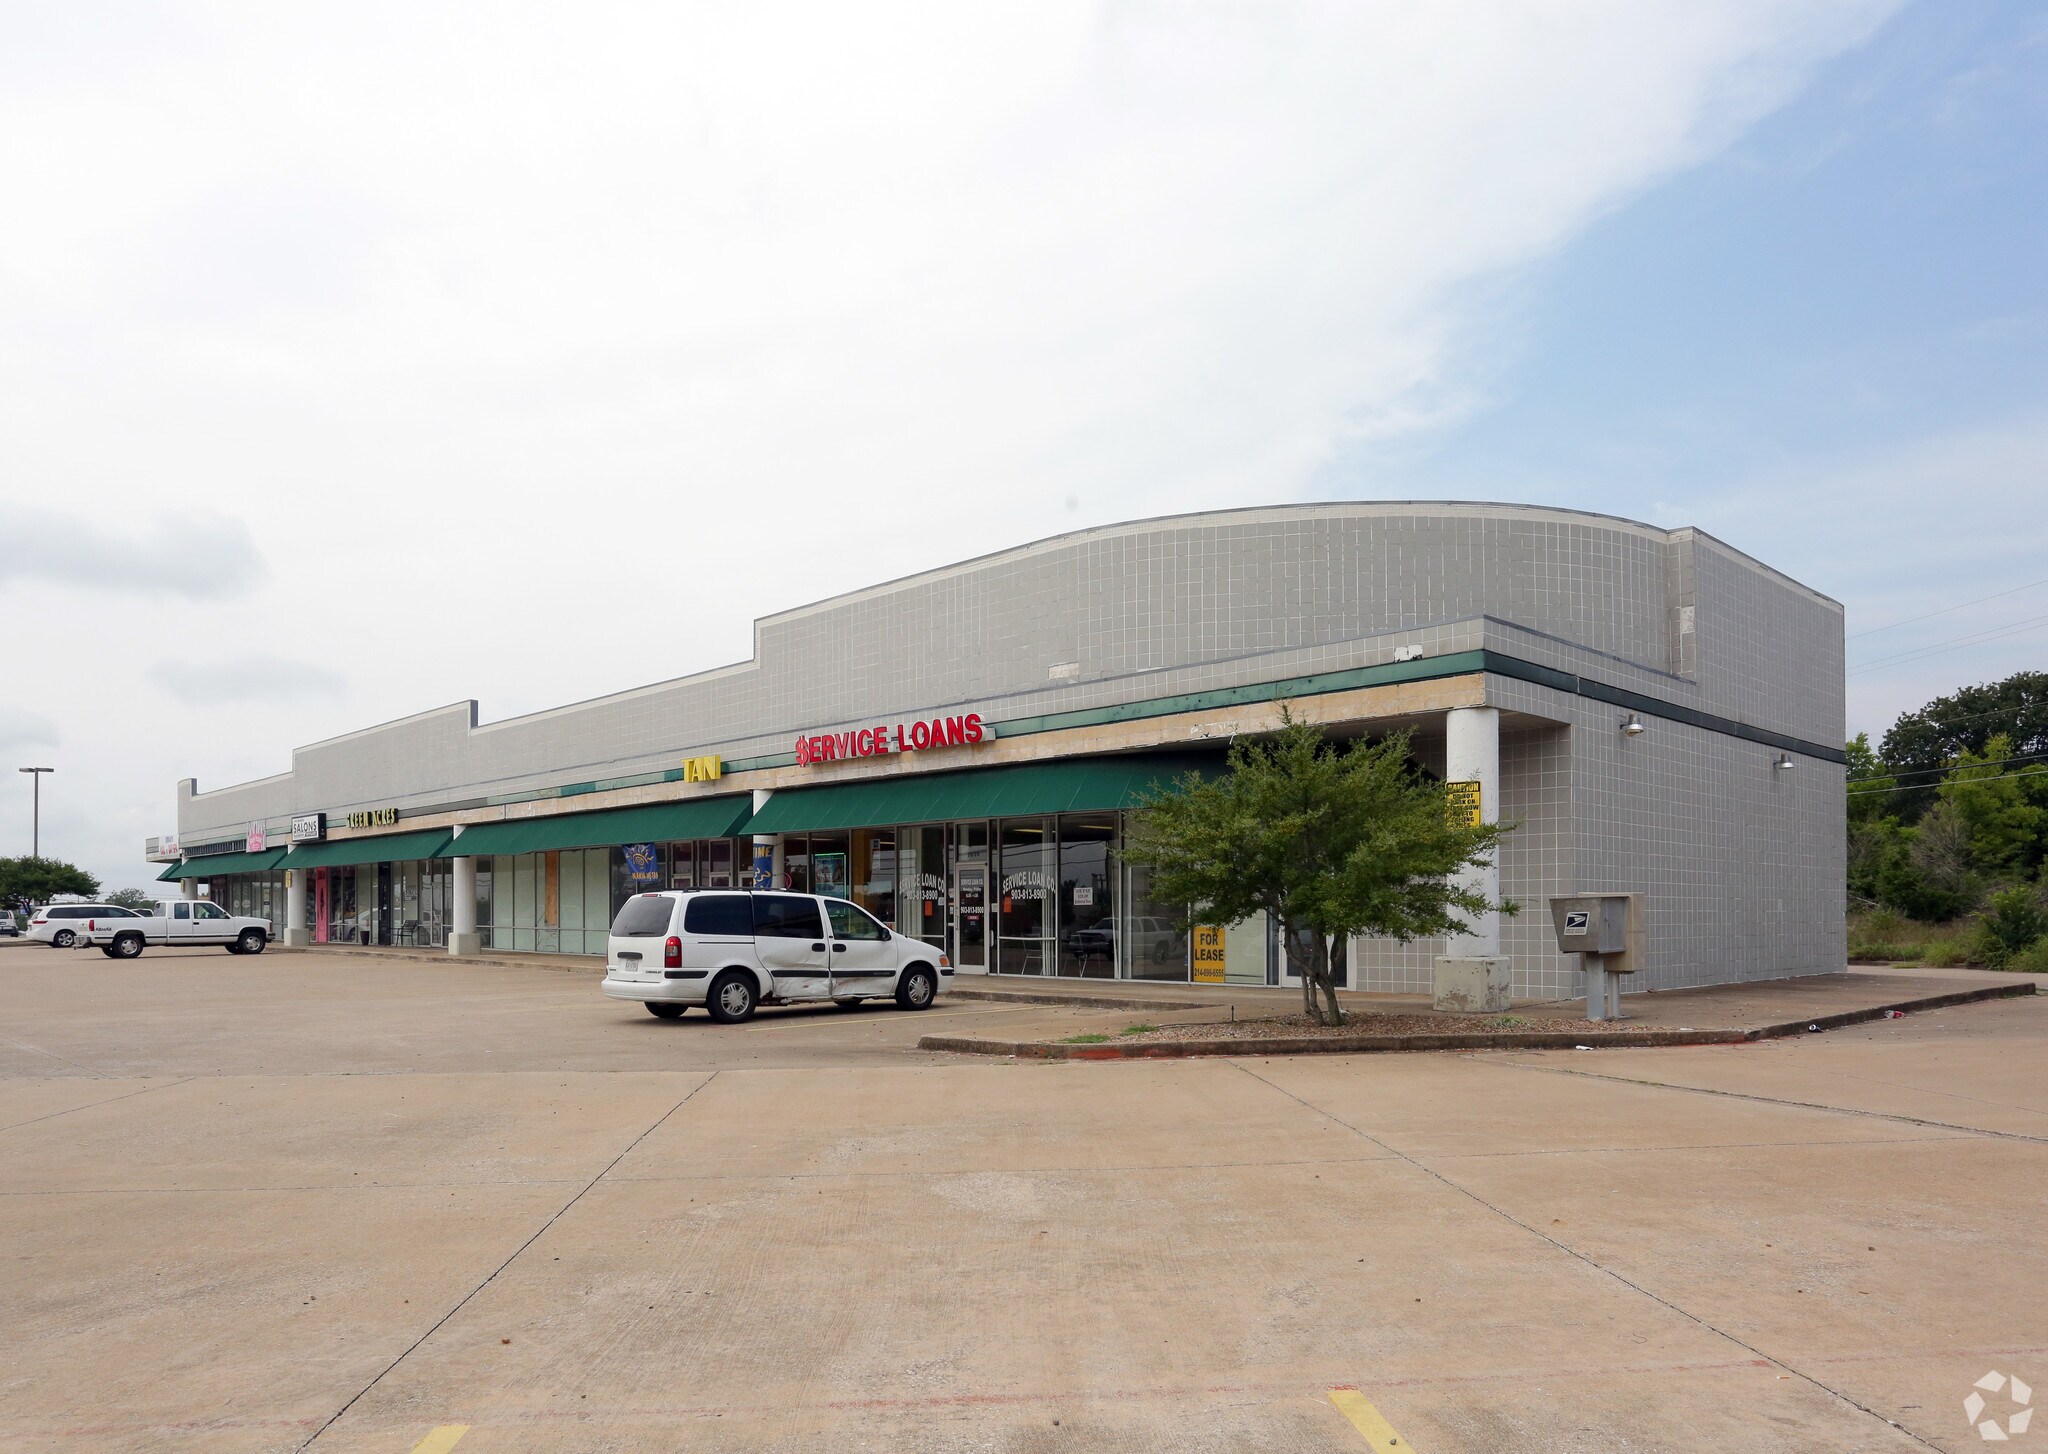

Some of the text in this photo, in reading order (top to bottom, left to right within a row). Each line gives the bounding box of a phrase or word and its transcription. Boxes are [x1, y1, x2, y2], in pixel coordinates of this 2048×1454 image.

[898, 713, 986, 751] LOANS
[680, 754, 721, 784] TAN
[346, 808, 397, 829] GREEN ACRES
[293, 820, 317, 834] SALONS
[921, 873, 937, 888] LOAN
[1002, 871, 1026, 895] SERVICE
[1028, 871, 1046, 887] LOAN
[906, 889, 938, 900] 903-813-8900
[1010, 889, 1047, 900] 903-813-8900
[1200, 933, 1218, 945] FOR
[1195, 949, 1224, 961] LEASE
